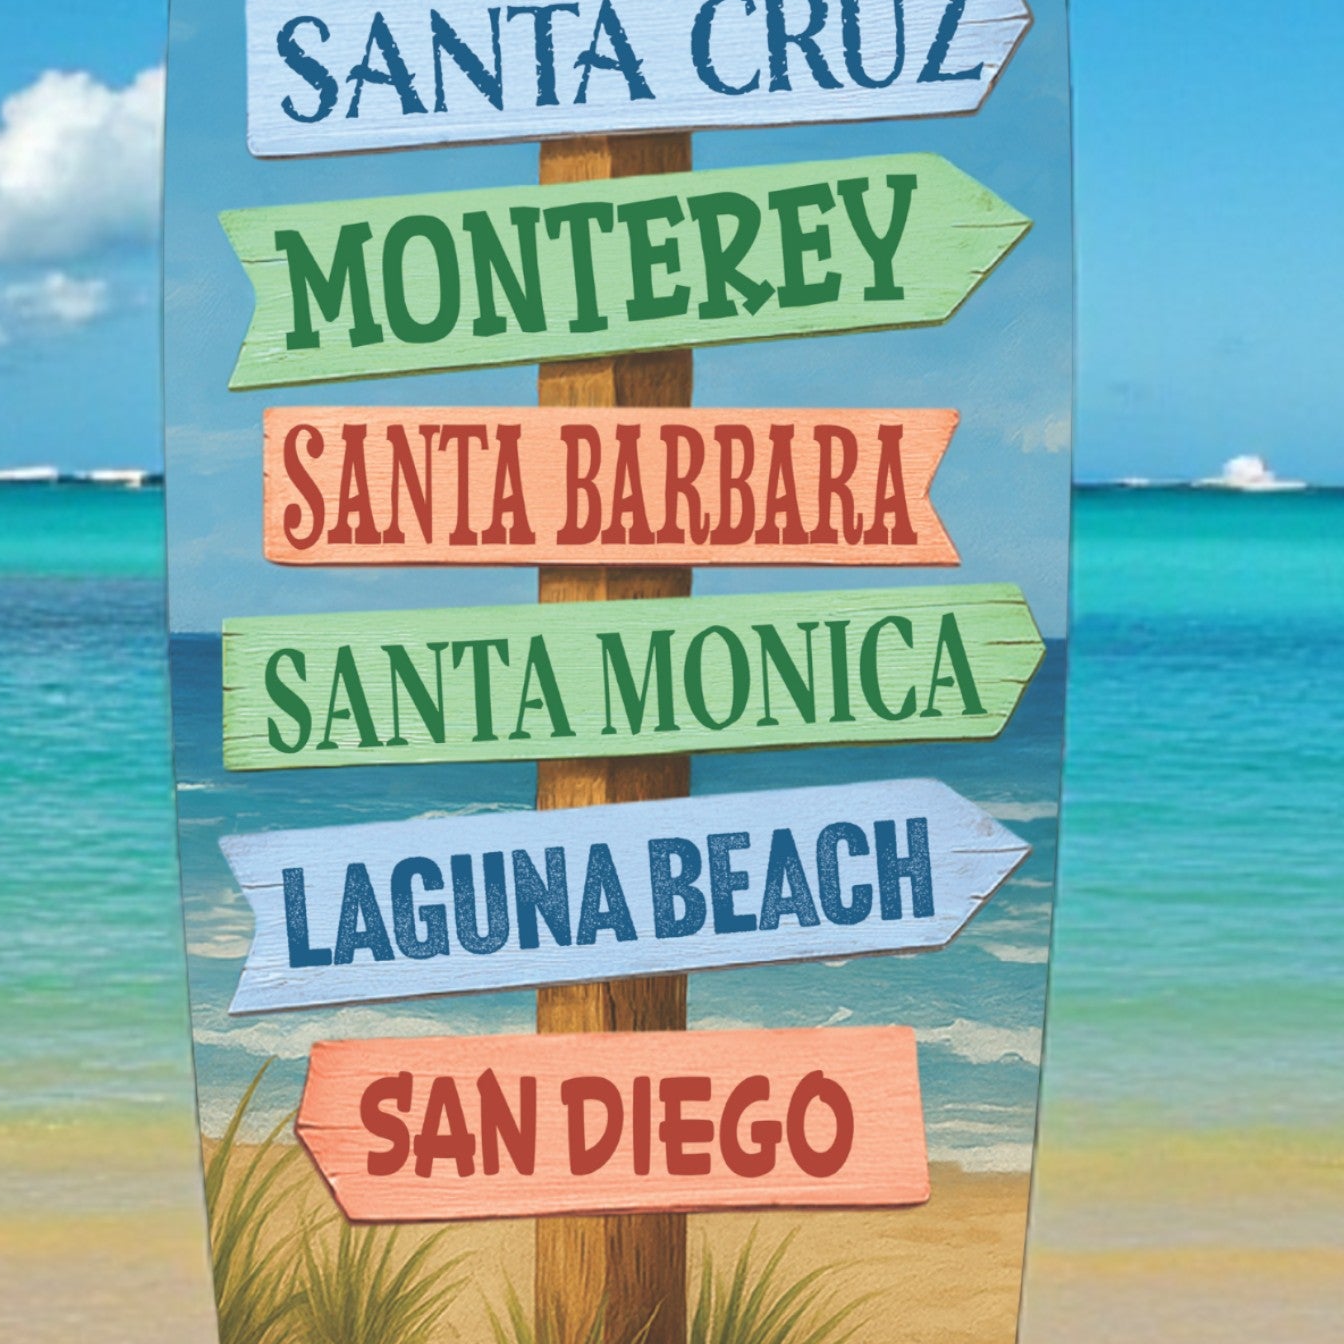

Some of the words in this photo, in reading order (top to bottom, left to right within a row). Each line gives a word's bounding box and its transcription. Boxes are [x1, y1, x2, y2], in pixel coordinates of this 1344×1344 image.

[274, 174, 918, 350] MONTEREY
[283, 424, 536, 551] SANTA
[556, 424, 918, 546] BARBARA
[265, 634, 577, 754] SANTA
[596, 612, 988, 736] MONICA
[282, 843, 638, 968] LAGUNA
[648, 817, 935, 939] BEACH
[360, 1067, 537, 1178] SAN
[560, 1069, 854, 1178] DIEGO
